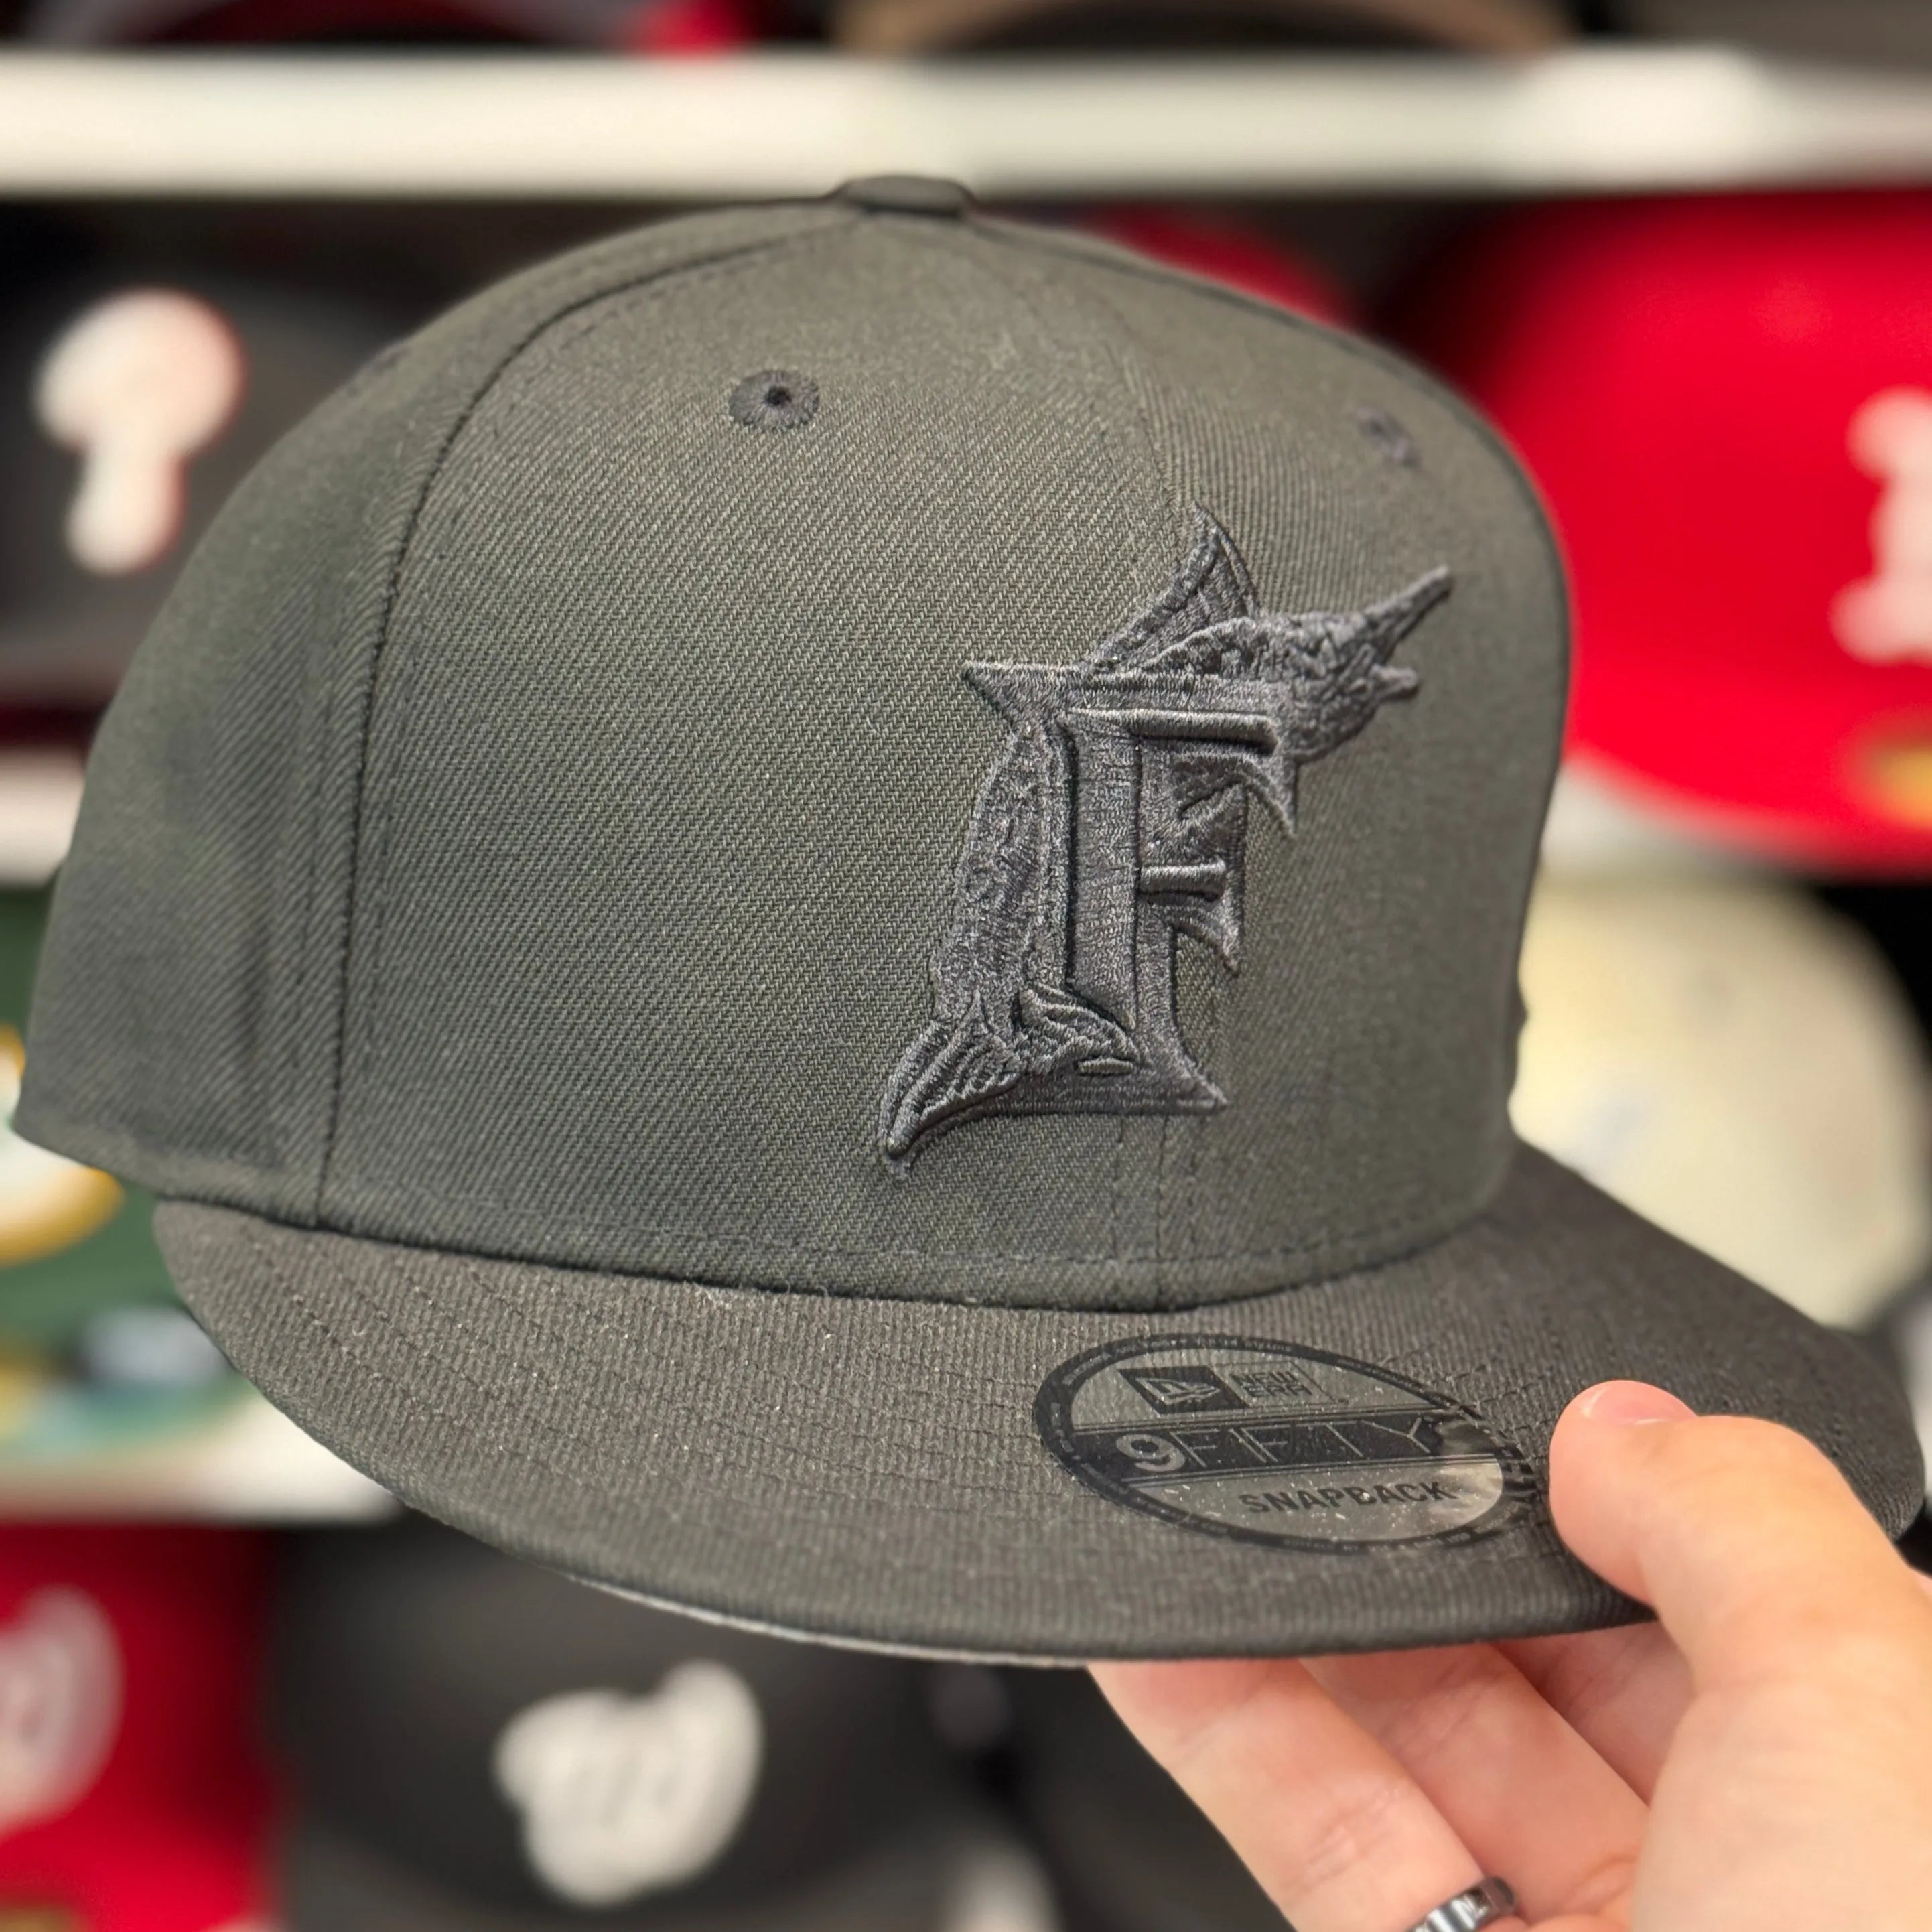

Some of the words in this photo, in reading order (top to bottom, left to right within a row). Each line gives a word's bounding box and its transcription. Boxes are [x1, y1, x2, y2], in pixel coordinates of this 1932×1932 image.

[1229, 1371, 1298, 1385] NEW
[1243, 1383, 1313, 1398] ERA
[1115, 1417, 1431, 1472] 9FIFTY
[1239, 1480, 1458, 1513] SNAPBACK
